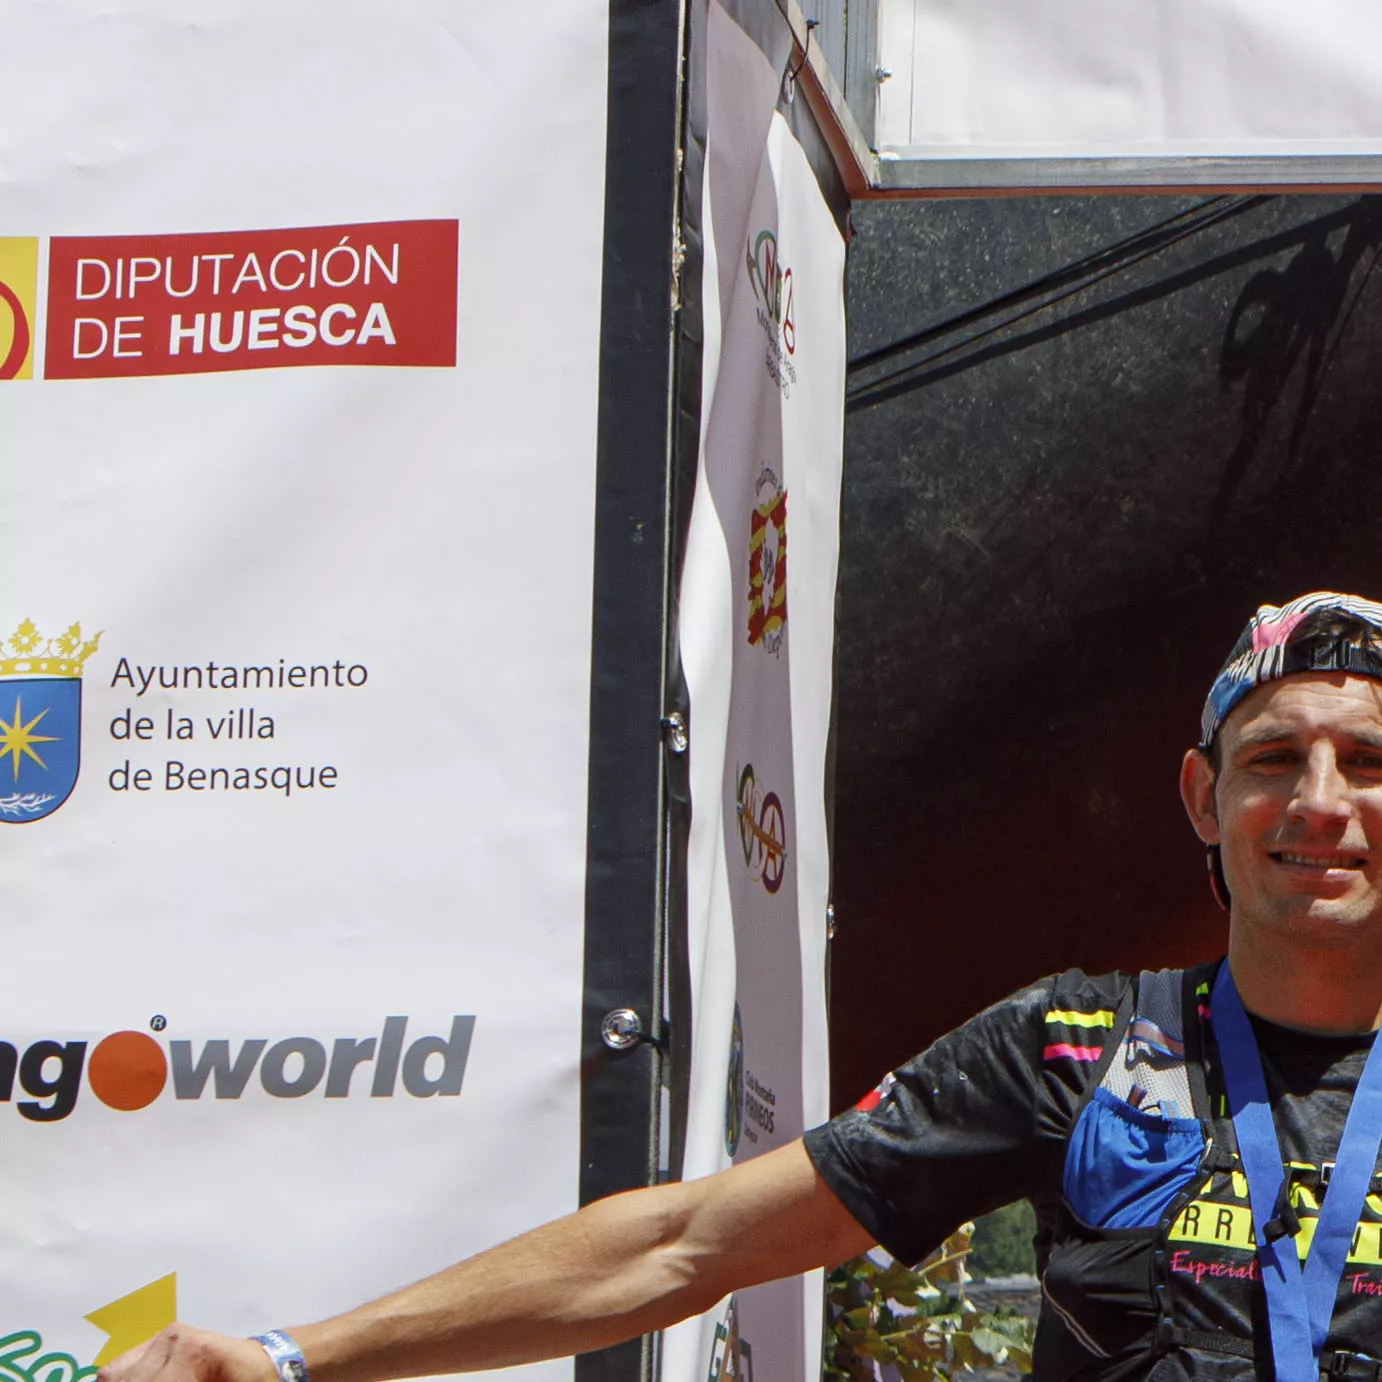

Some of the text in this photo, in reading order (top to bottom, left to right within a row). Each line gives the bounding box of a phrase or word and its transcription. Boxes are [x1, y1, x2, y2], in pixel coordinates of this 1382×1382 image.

[75, 234, 401, 301] DIPUTACIÓN
[72, 302, 397, 360] DE HUESCA
[110, 657, 369, 696] Ayuntamiento
[109, 707, 276, 742] de la villa
[108, 761, 339, 798] de Benasque
[1170, 1250, 1265, 1284] Especial
